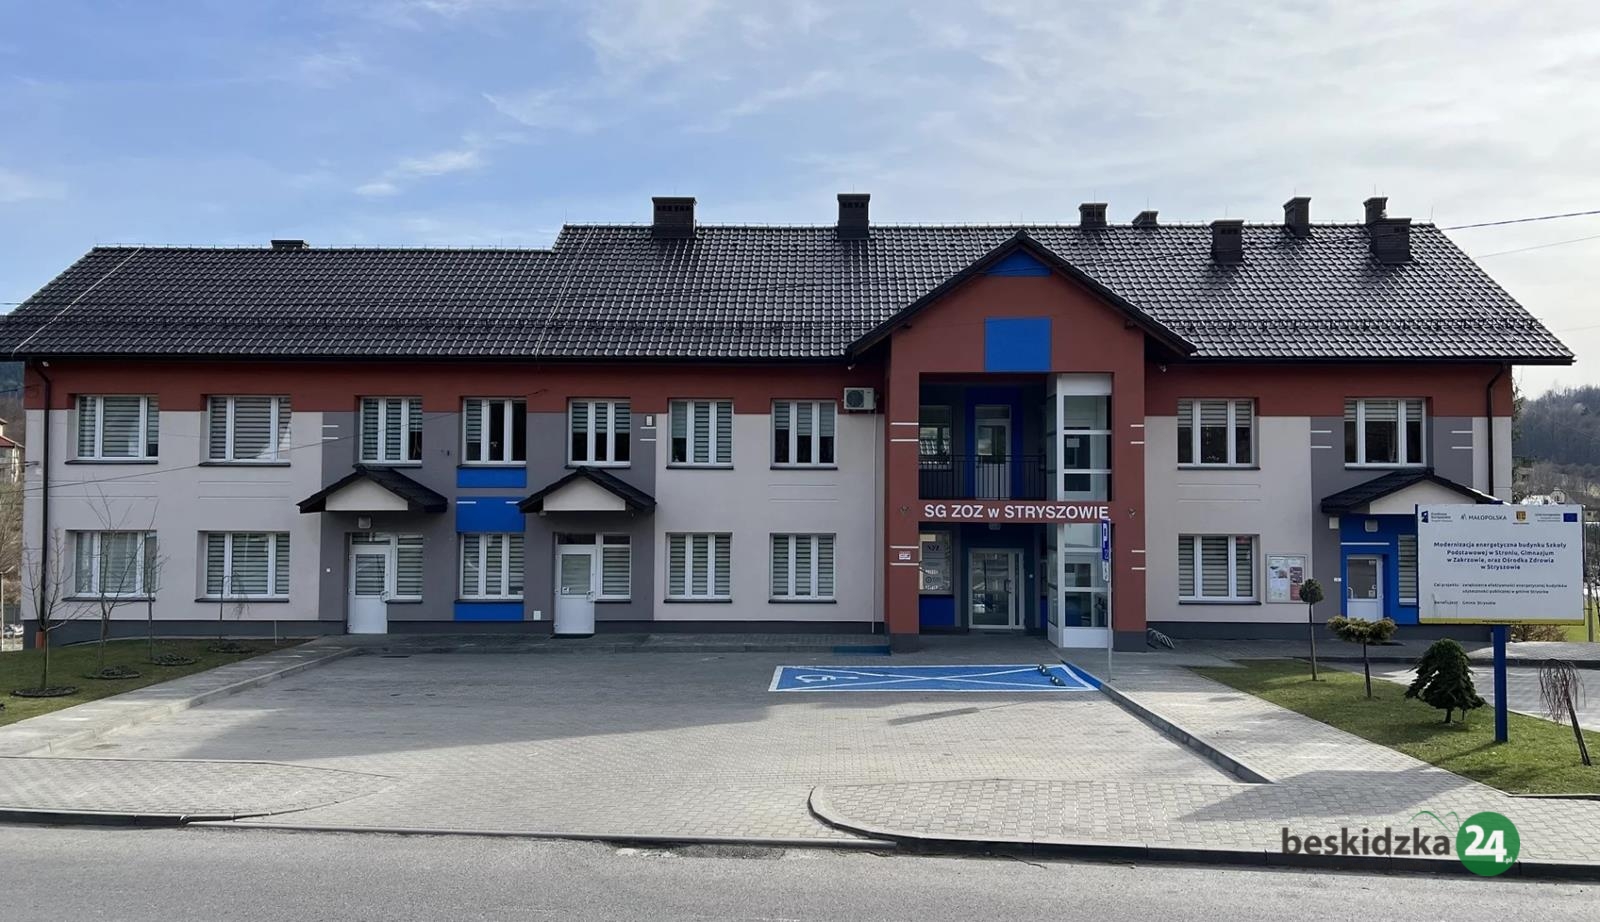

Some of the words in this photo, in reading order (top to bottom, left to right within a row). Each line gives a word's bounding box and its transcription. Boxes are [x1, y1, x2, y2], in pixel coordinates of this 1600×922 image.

[924, 504, 947, 518] SG
[951, 505, 984, 518] ZOZ
[988, 507, 1000, 518] w
[1005, 505, 1109, 519] STRYSZOWIE
[1434, 542, 1475, 550] Modernizacja
[1476, 542, 1518, 550] energetyczna
[1518, 542, 1545, 550] budynku
[1546, 542, 1567, 550] Szkoły
[1447, 550, 1488, 558] Podstawowej
